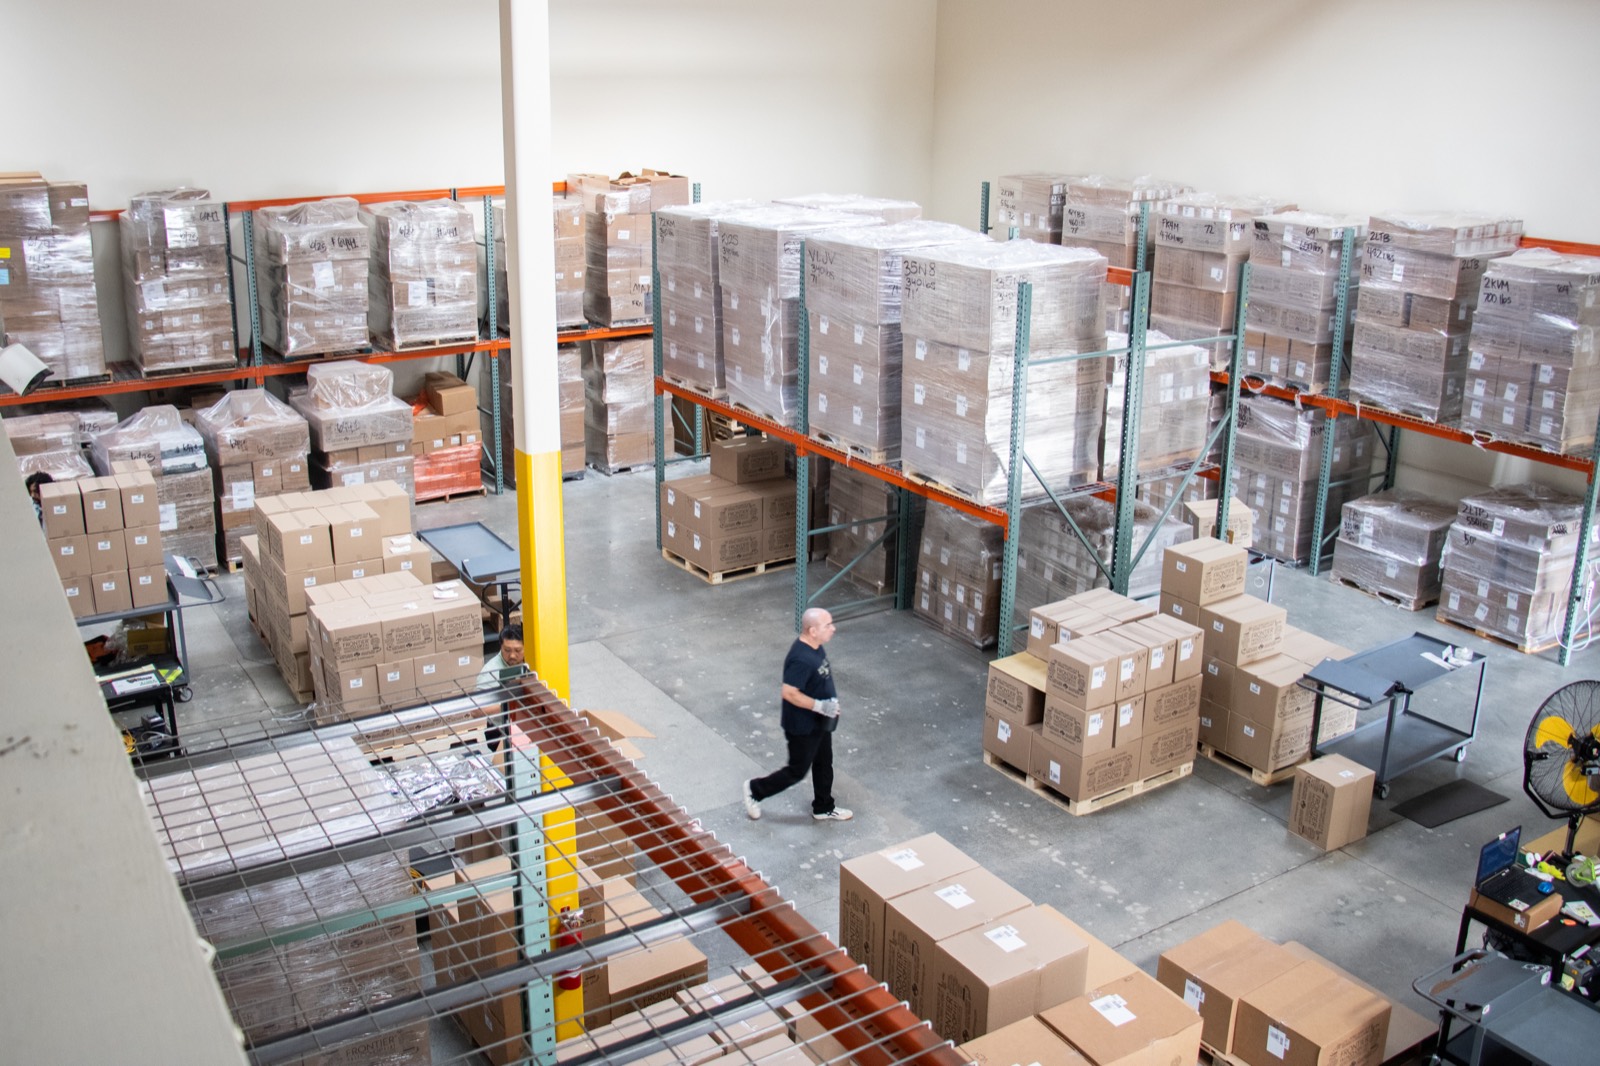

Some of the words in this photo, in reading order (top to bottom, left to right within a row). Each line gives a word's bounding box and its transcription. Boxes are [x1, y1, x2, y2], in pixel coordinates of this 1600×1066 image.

[1370, 231, 1390, 242] 2LTB
[903, 260, 936, 277] 35N8
[1461, 258, 1480, 270] 2LTB
[1483, 276, 1510, 292] 2KVM
[396, 630, 421, 640] FRONTIER
[342, 640, 370, 649] FRONTIER
[1056, 668, 1077, 681] FRONTIER
[1164, 693, 1187, 704] FRONTIER
[1160, 736, 1184, 748] FRONTIER
[944, 996, 953, 1040] RONTIER
[345, 1036, 395, 1056] FRONTIER
